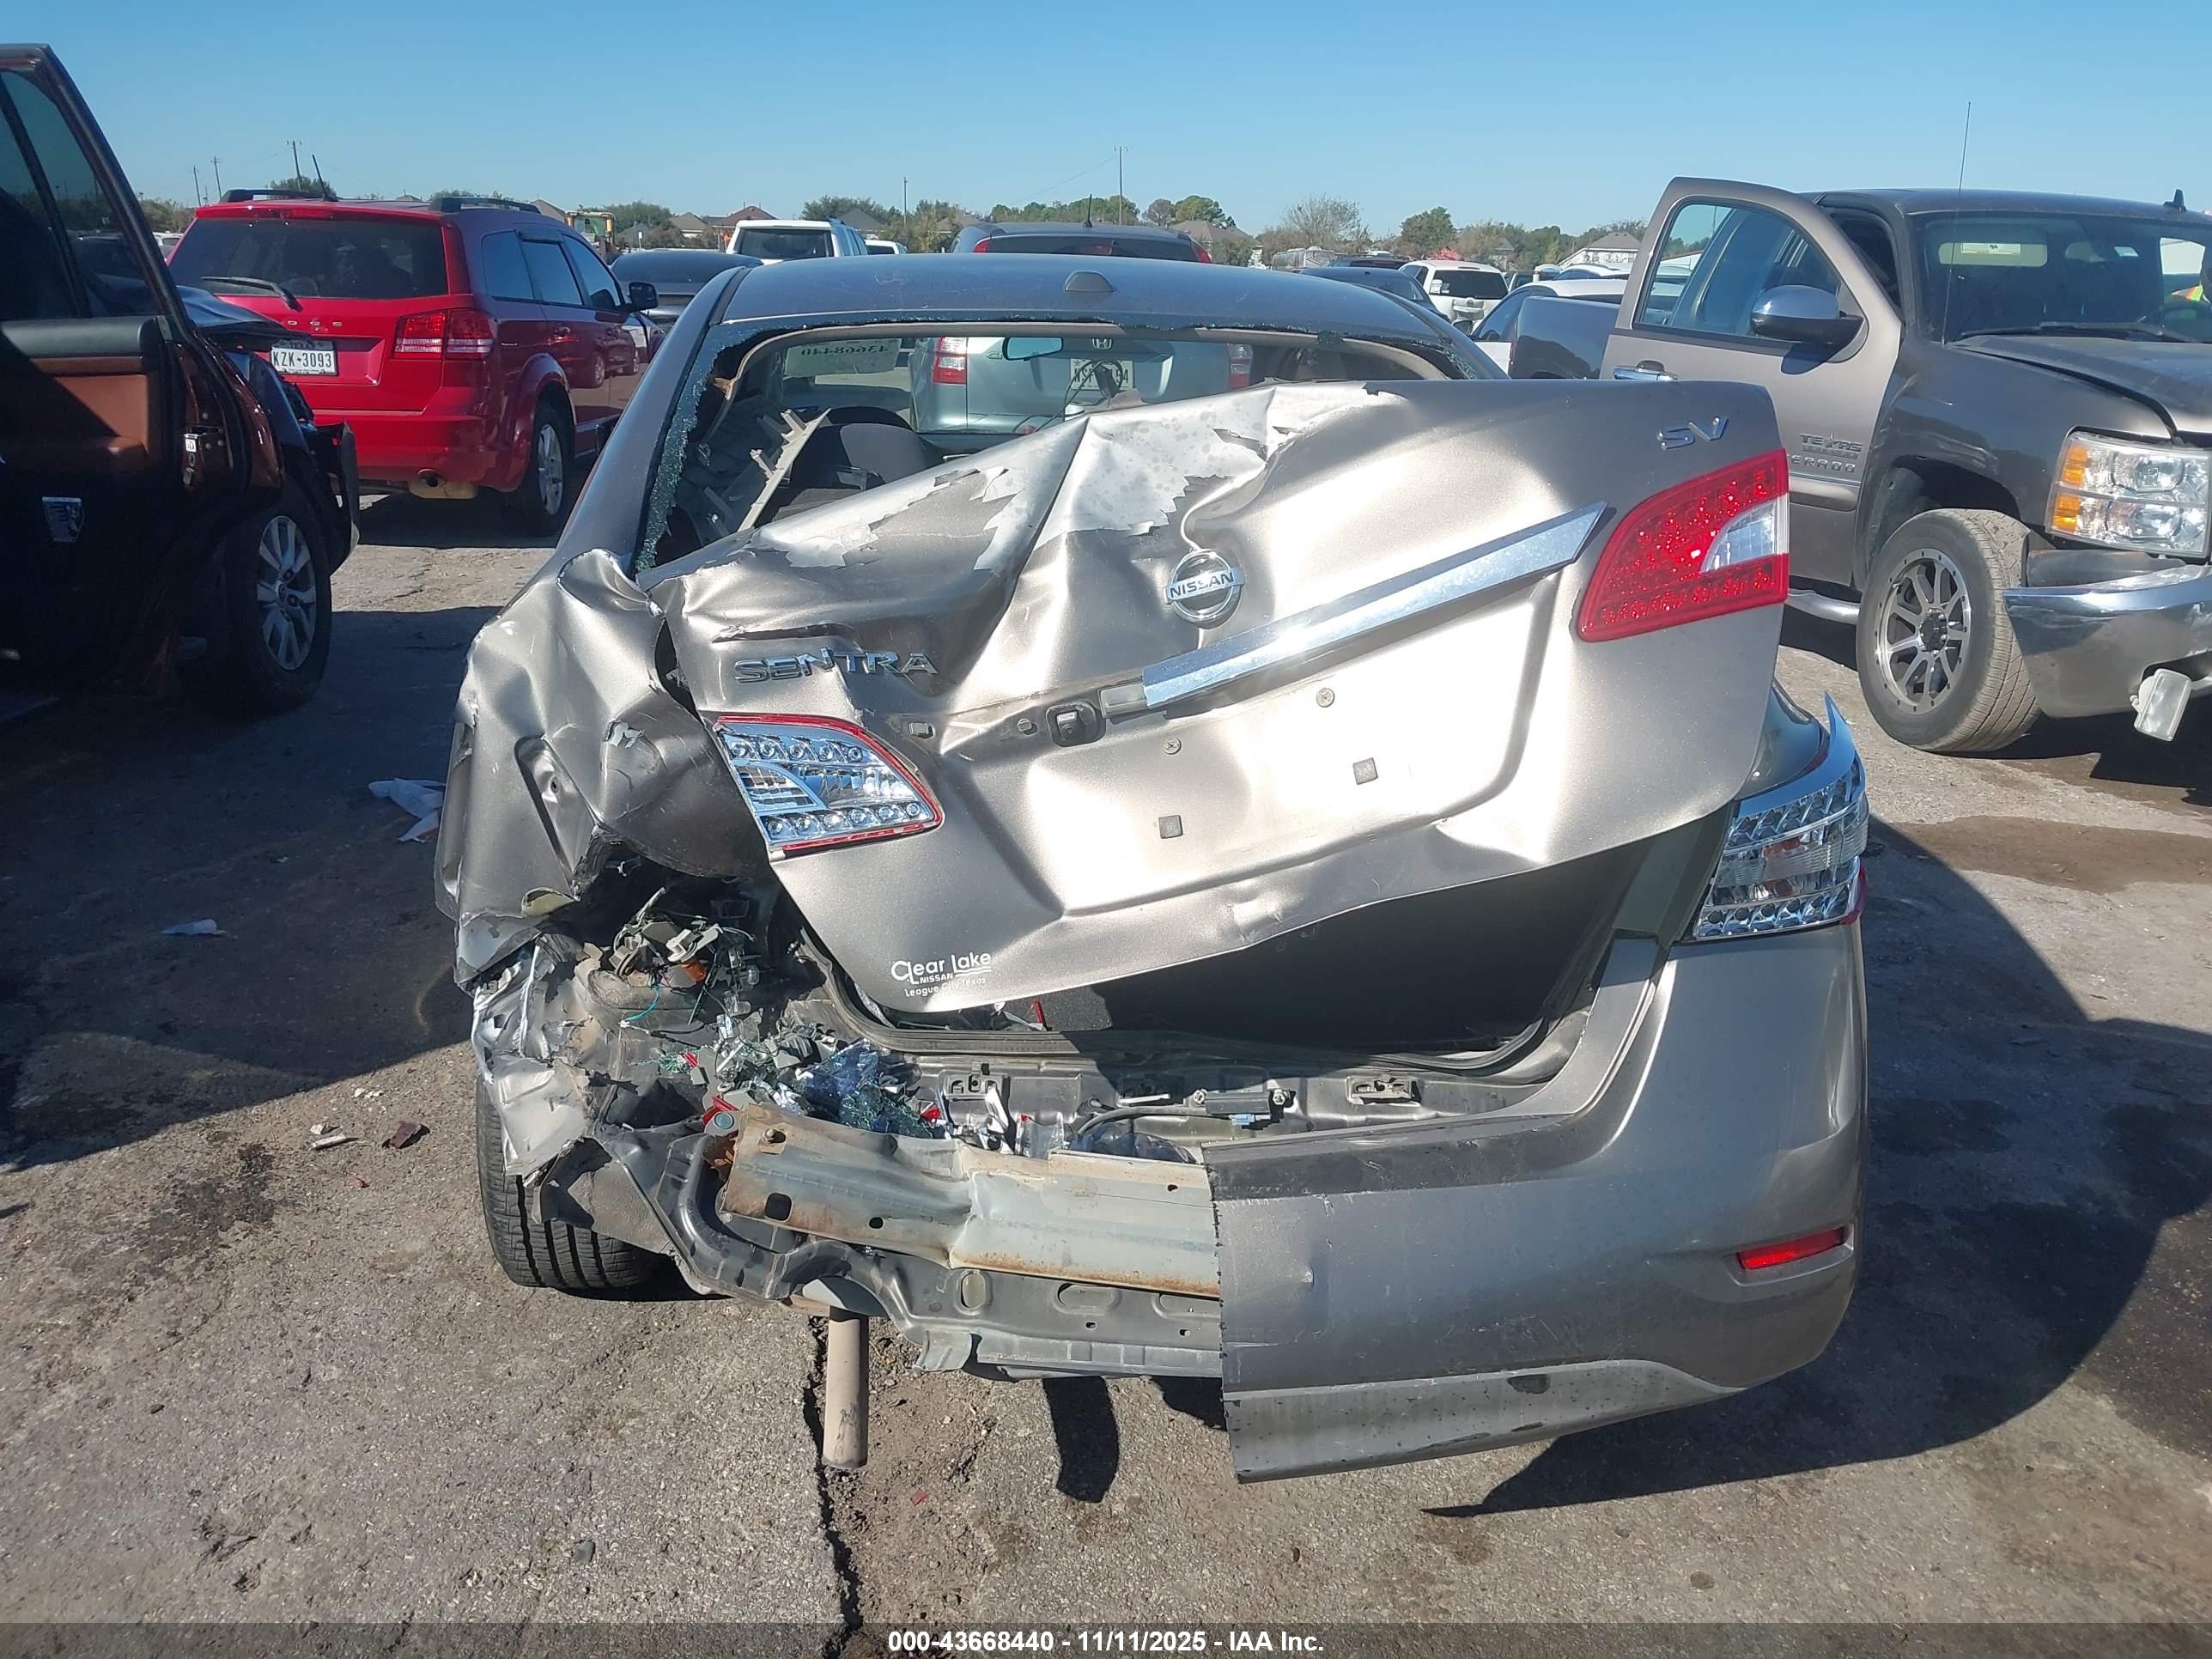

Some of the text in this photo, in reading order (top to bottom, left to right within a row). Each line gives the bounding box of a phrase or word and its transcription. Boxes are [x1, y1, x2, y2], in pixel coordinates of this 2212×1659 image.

[301, 352, 331, 368] 3093
[1656, 416, 1729, 450] SV
[1170, 572, 1234, 599] NISSAN
[734, 646, 938, 684] SENTRA
[890, 951, 992, 985] Clear Lake
[919, 972, 954, 984] NISSAN
[904, 984, 939, 997] League
